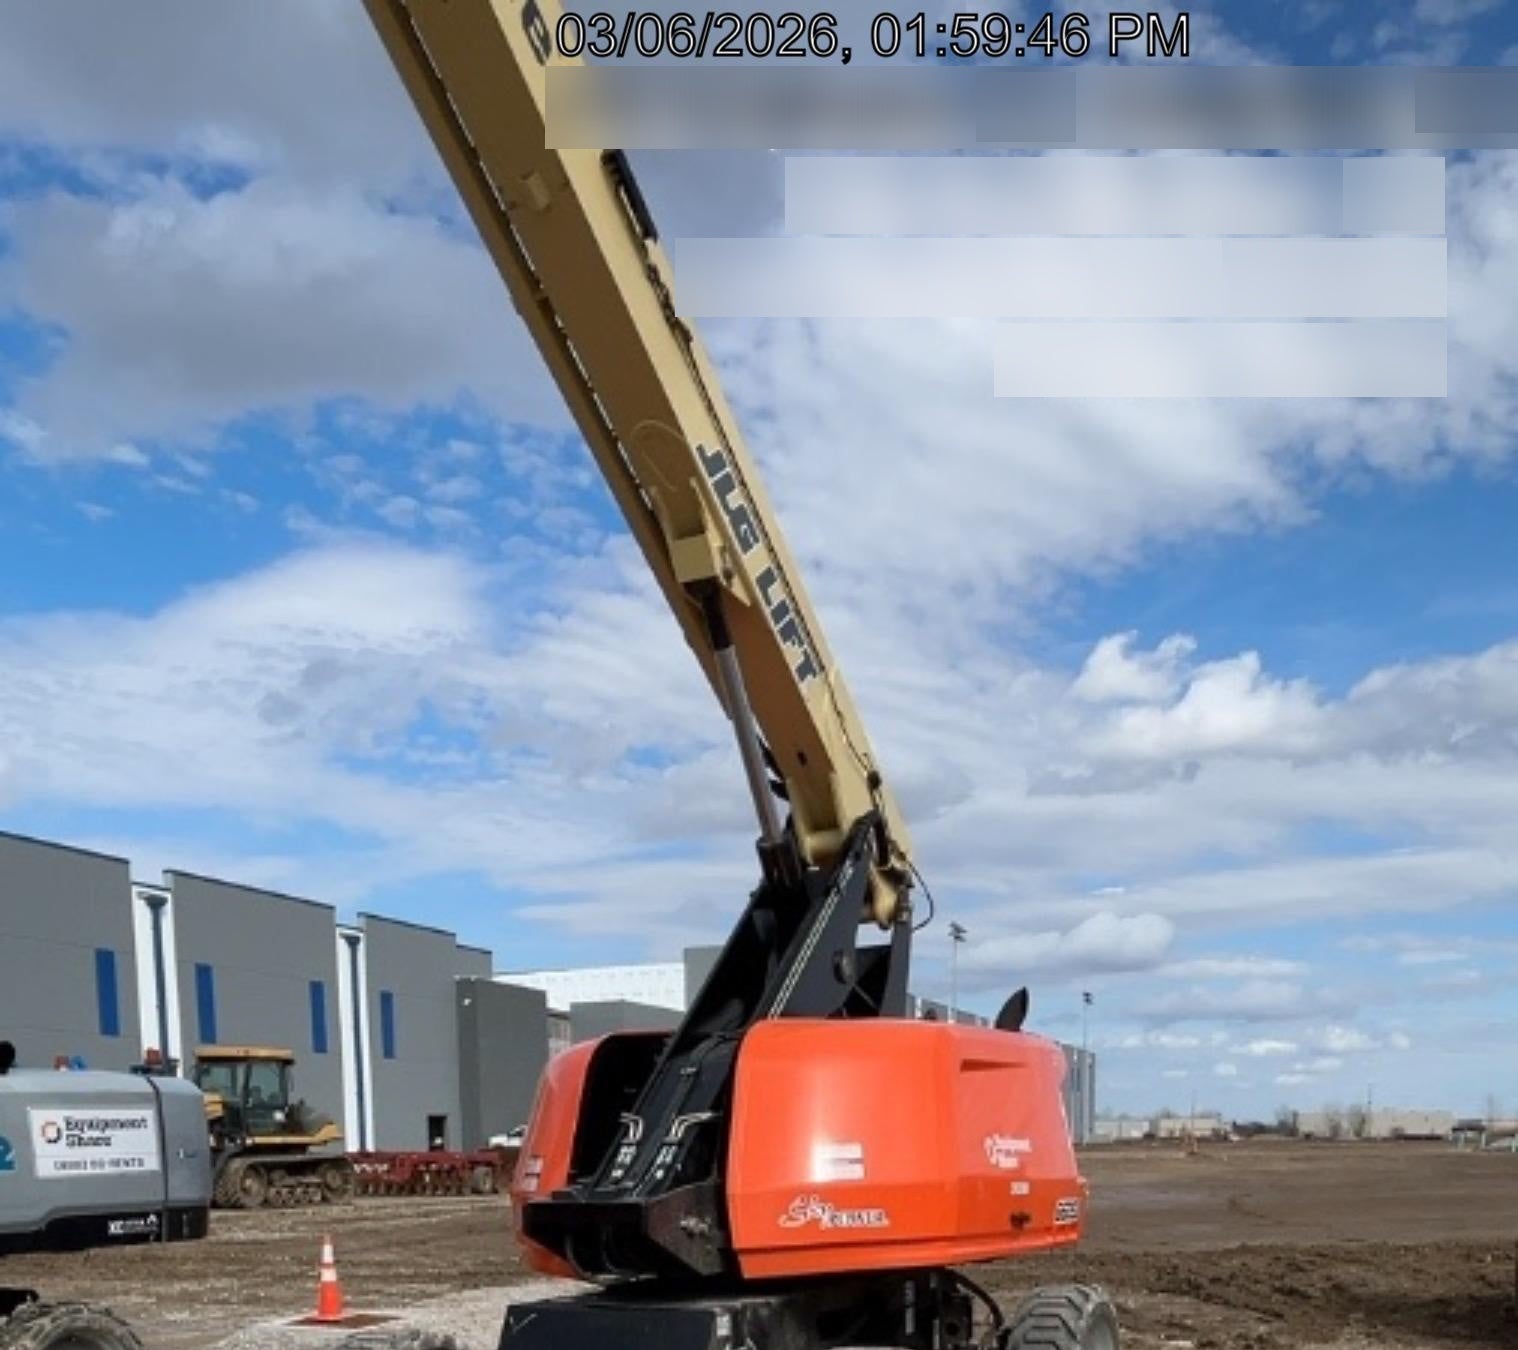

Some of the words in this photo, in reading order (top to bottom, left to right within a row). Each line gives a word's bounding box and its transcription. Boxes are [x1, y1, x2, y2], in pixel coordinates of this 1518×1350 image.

[696, 443, 759, 554] JLG
[755, 566, 826, 682] LIFT
[64, 1115, 148, 1132] Equipment
